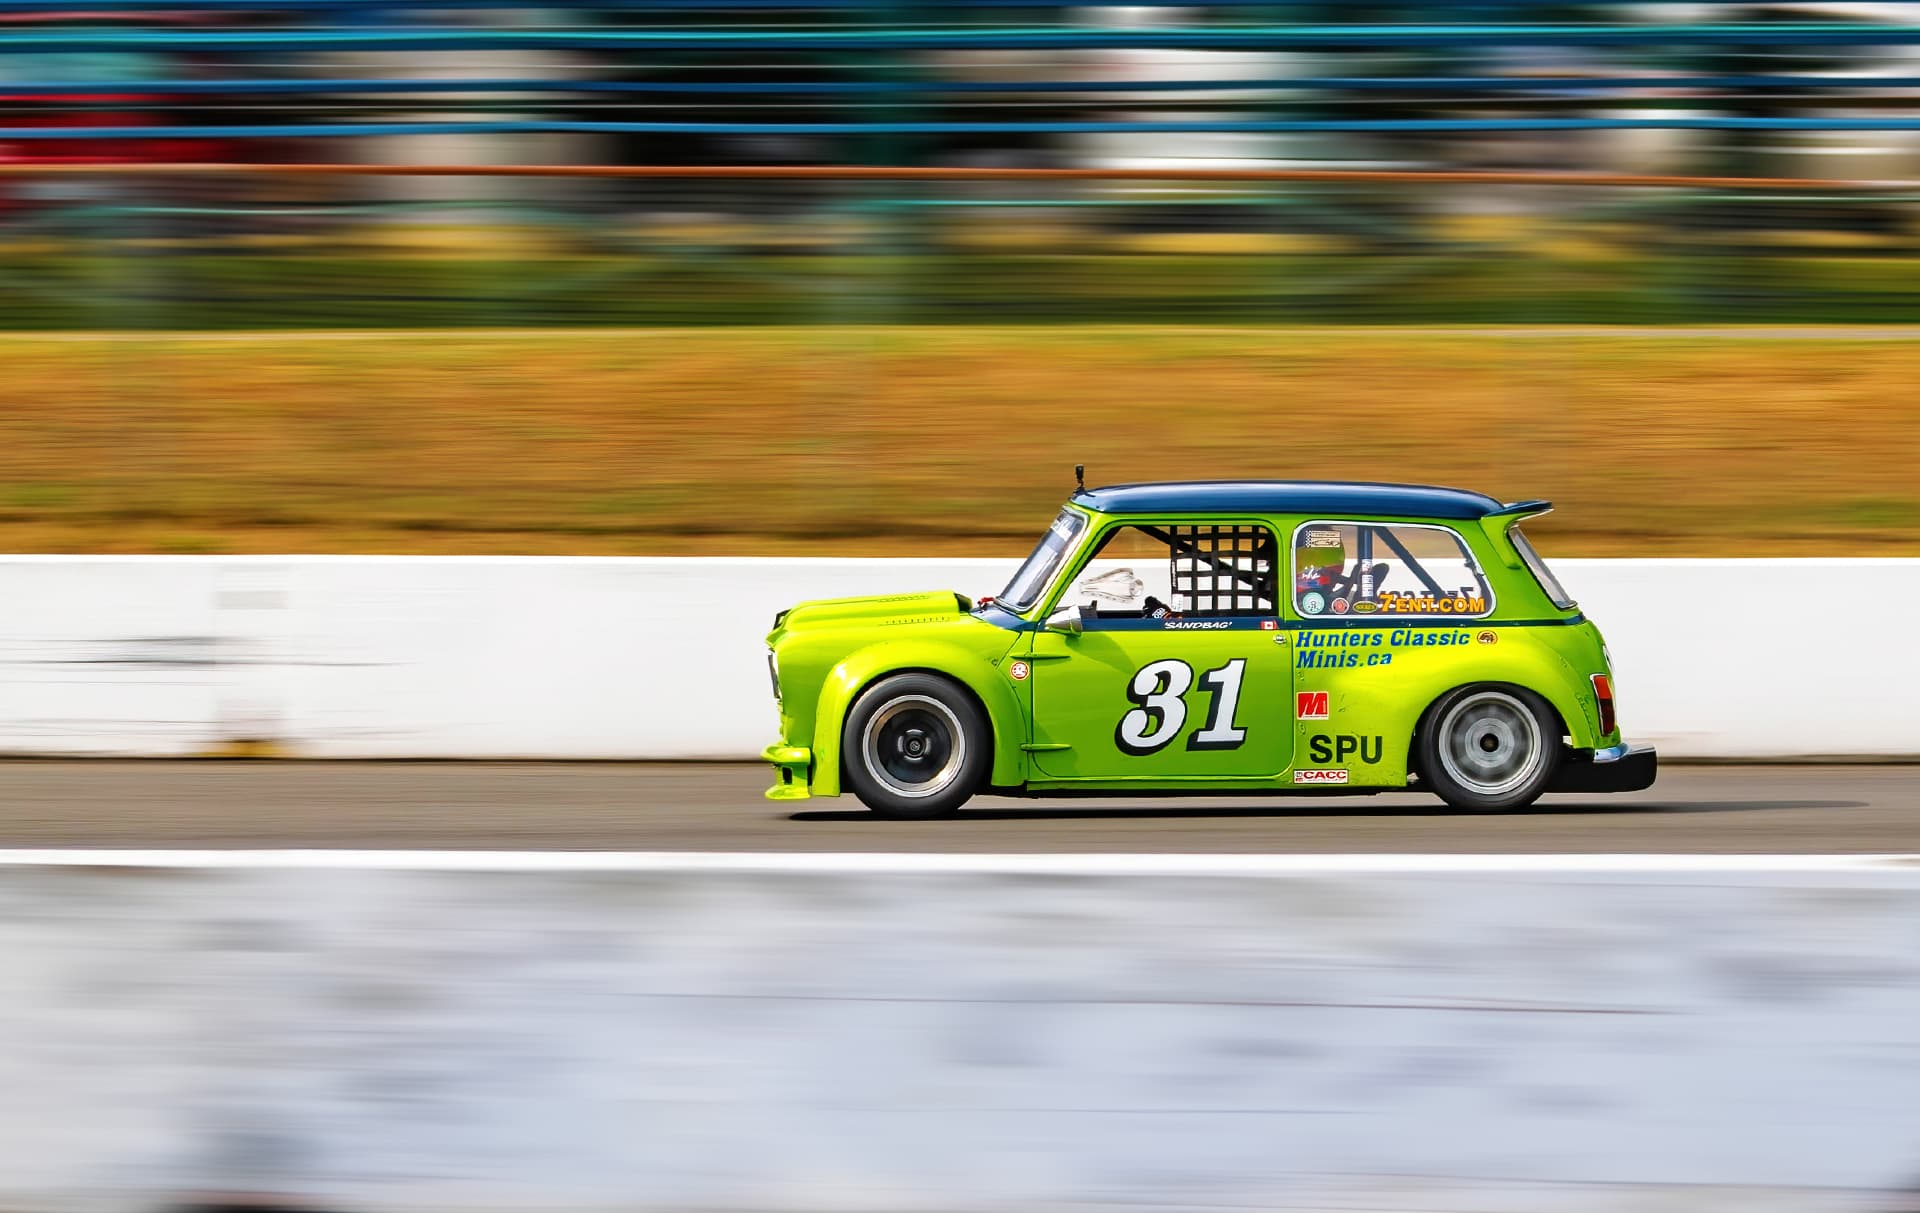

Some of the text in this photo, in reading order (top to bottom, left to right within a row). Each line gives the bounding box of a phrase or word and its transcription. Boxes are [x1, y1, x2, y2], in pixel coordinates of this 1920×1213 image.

[1378, 593, 1486, 613] 7ENT.COM
[1296, 629, 1471, 648] Hunters Classic
[1296, 649, 1393, 669] Minis.ca
[1114, 657, 1248, 757] 31
[1309, 734, 1383, 765] SPU
[1303, 771, 1347, 779] CACC
